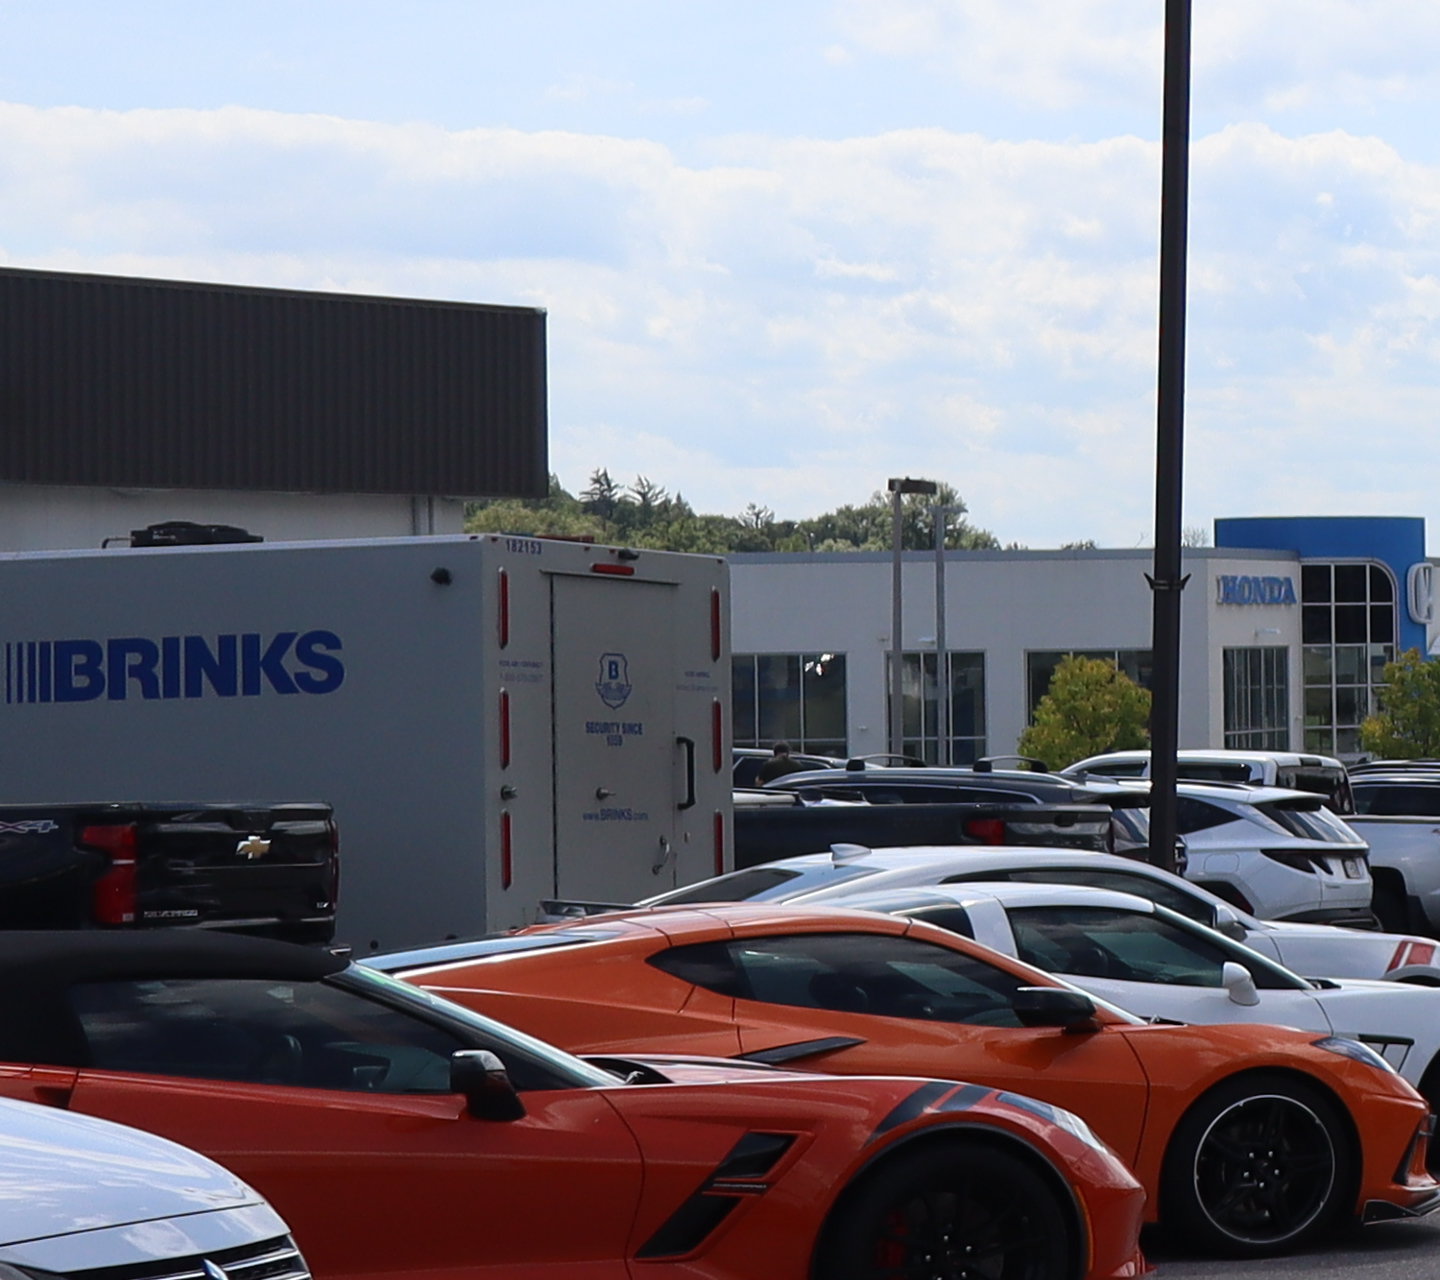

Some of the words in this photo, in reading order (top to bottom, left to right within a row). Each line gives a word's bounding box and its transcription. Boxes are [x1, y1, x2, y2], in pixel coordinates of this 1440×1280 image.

[505, 539, 542, 556] 182153
[1218, 575, 1297, 606] HONDA
[53, 629, 345, 703] BRINKS
[608, 660, 619, 680] B
[585, 721, 620, 734] SECURITY
[622, 722, 643, 735] SINCE
